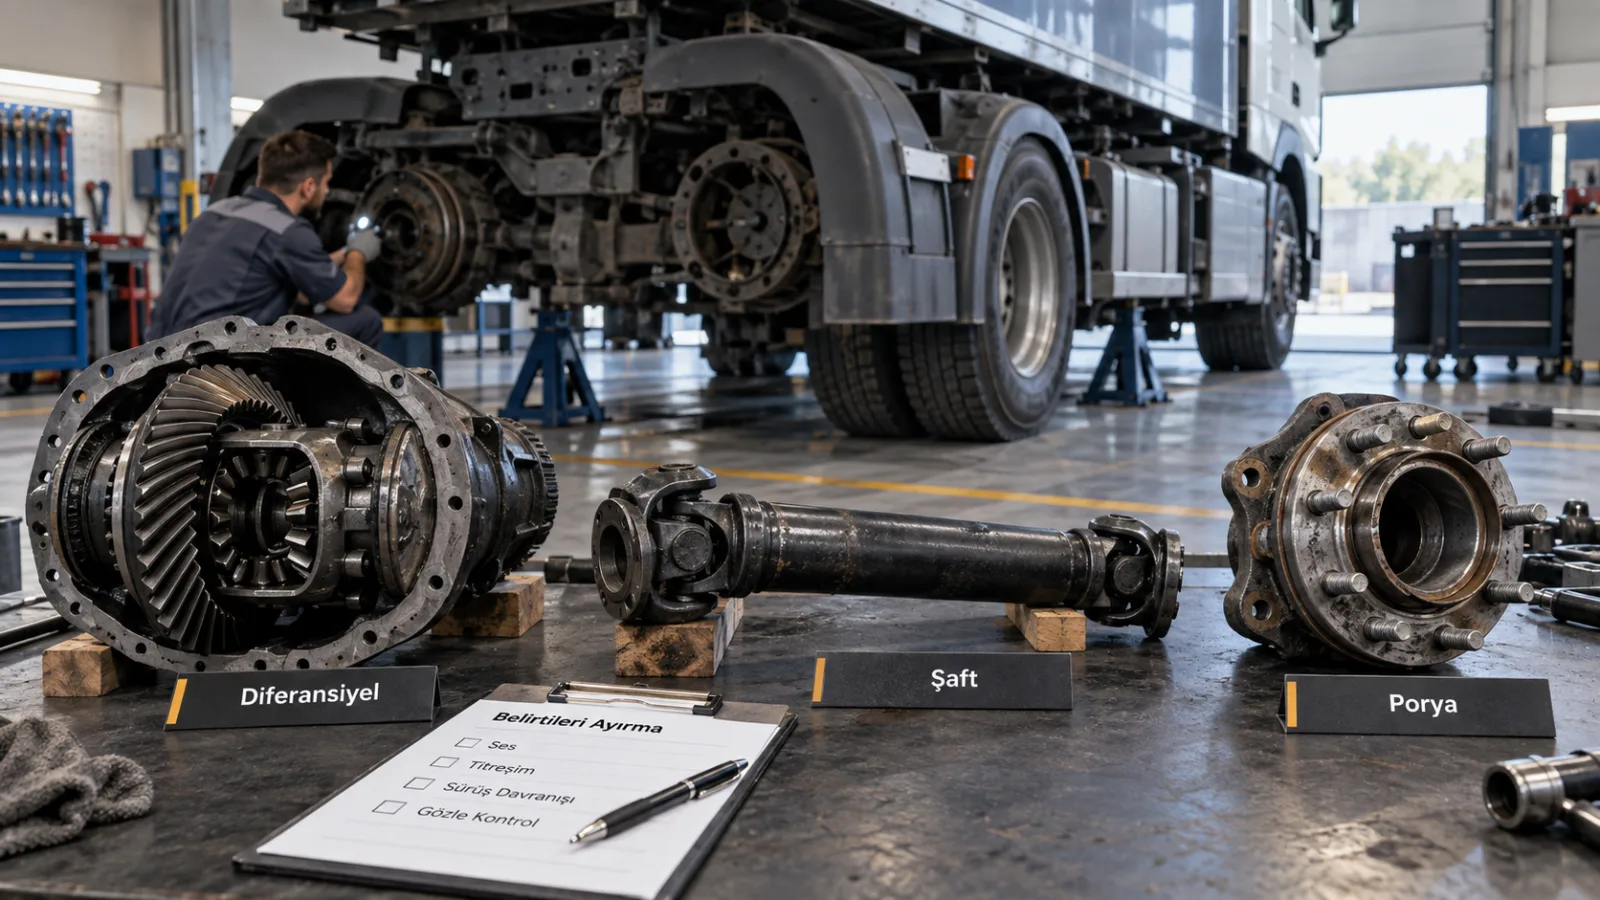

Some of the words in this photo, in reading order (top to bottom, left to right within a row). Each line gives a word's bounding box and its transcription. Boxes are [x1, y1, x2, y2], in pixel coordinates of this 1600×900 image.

[930, 668, 979, 693] Şaft
[240, 682, 380, 707] Diferansiyel
[1389, 693, 1459, 718] Porya
[492, 712, 588, 728] Belirtileri
[589, 718, 664, 734] Ayırma
[487, 740, 518, 752] Ses
[469, 760, 536, 776] Titreşim
[443, 781, 494, 798] Sürüş
[495, 787, 576, 805] Davranışı
[416, 805, 469, 821] Gözle
[471, 811, 540, 829] Kontrol
